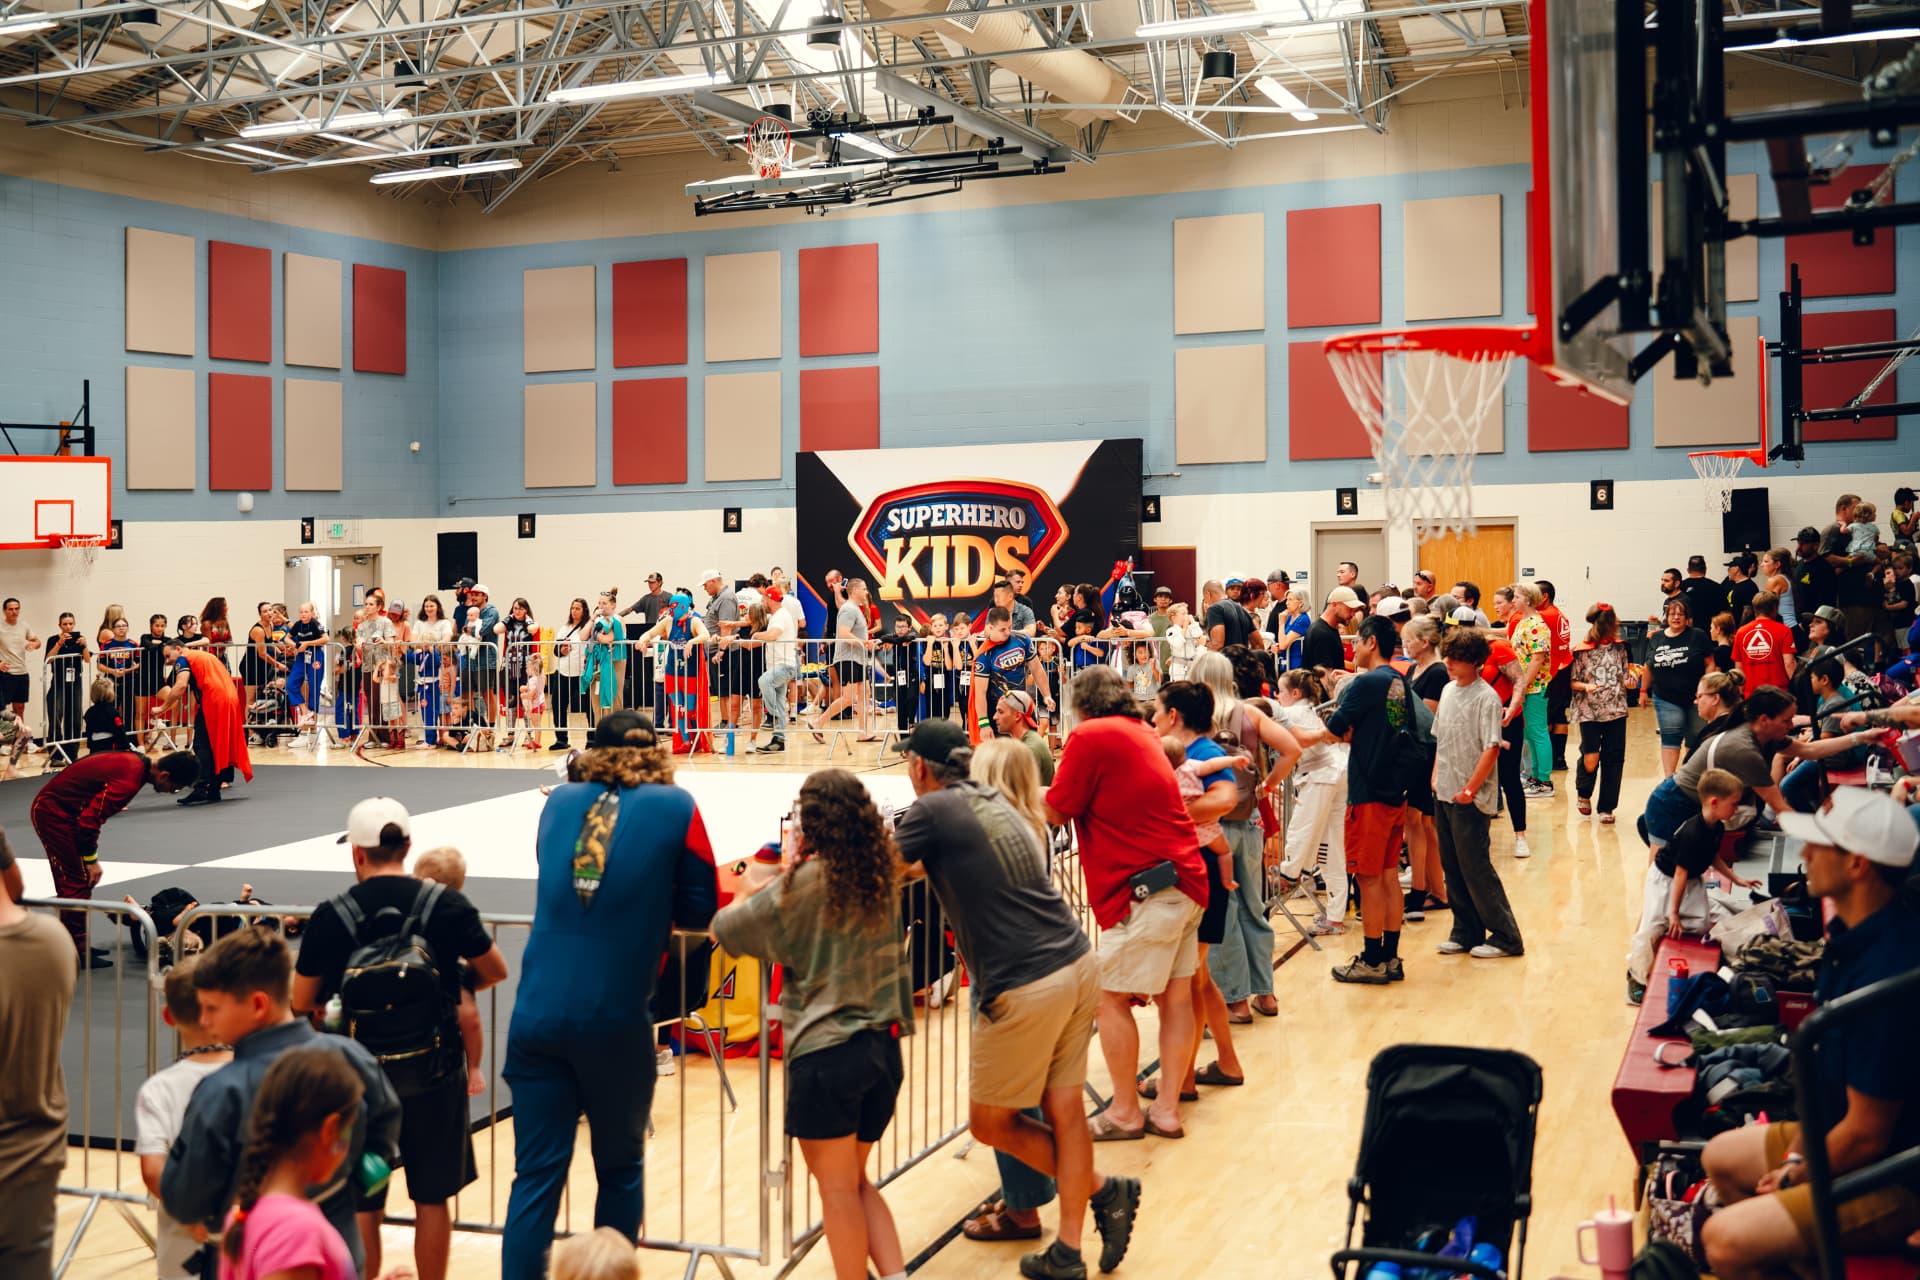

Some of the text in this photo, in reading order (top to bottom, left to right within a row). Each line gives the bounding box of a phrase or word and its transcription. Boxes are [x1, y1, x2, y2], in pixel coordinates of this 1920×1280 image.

[1597, 488, 1607, 501] 6
[1146, 502, 1155, 514] 4
[1343, 496, 1352, 508] 5
[729, 513, 737, 525] 2
[887, 503, 1026, 532] SUPERHERO
[878, 534, 1033, 600] KIDS
[1000, 653, 1025, 669] KIDS
[1595, 664, 1618, 687] 93
